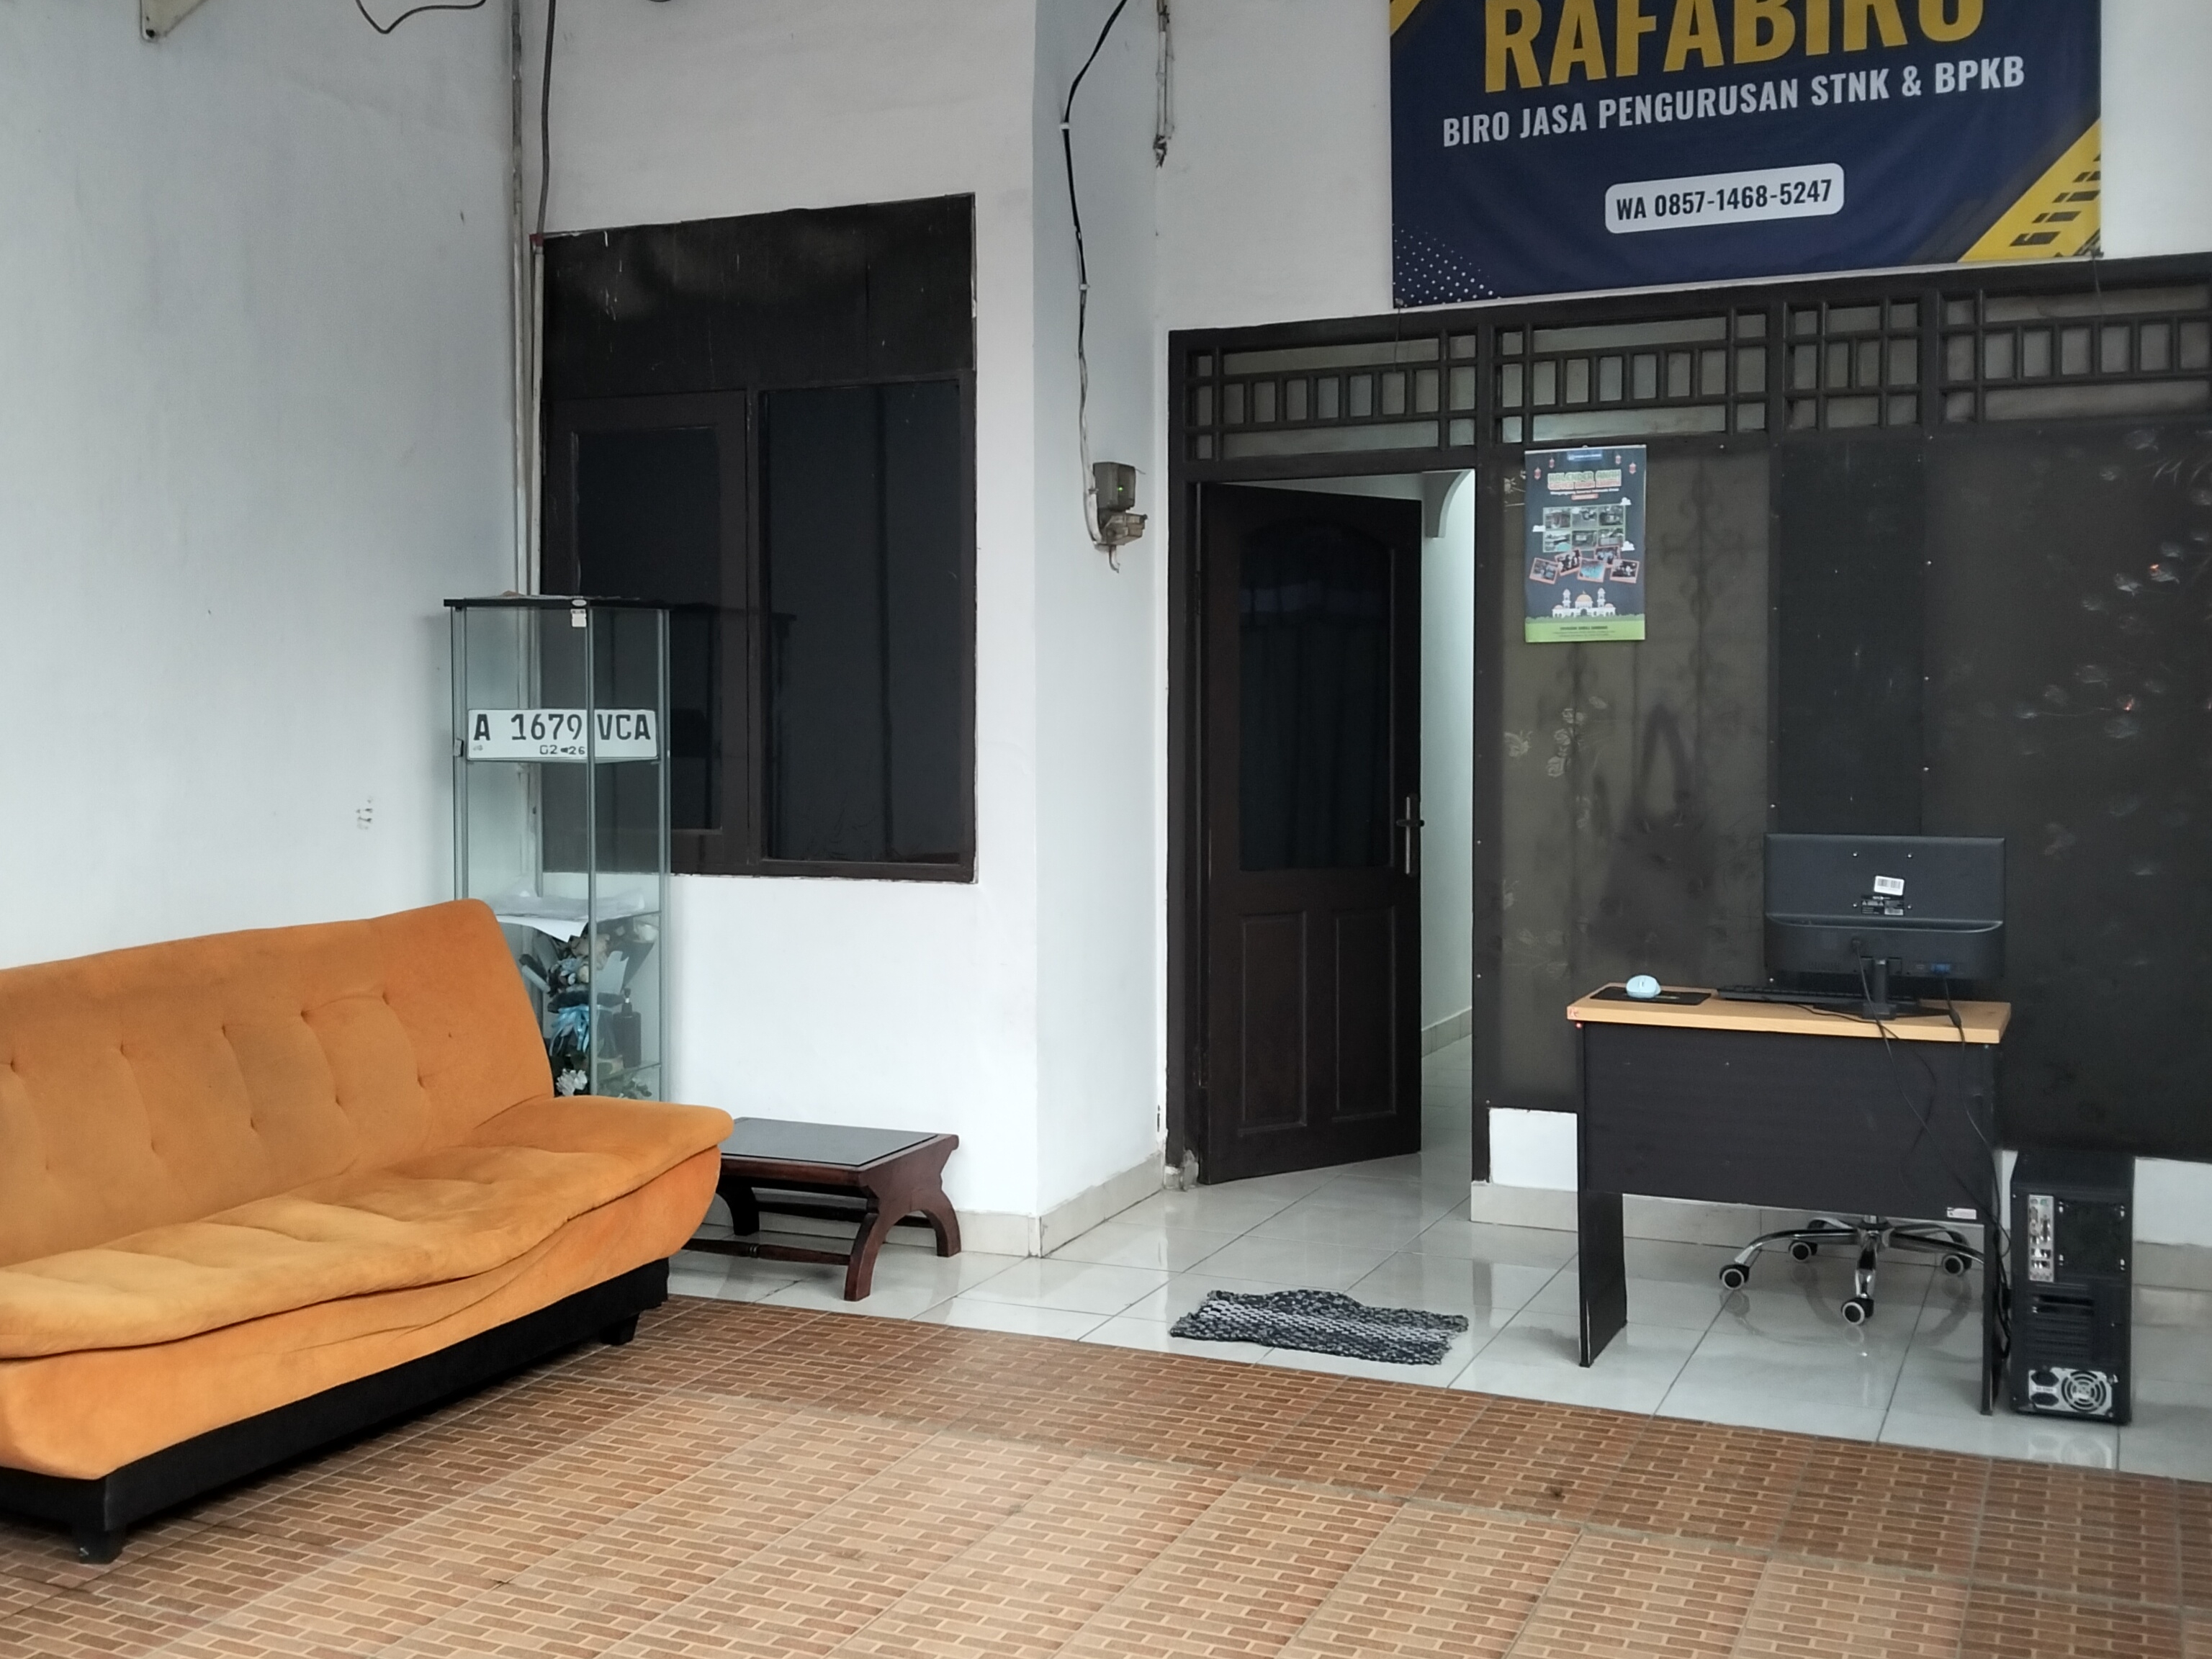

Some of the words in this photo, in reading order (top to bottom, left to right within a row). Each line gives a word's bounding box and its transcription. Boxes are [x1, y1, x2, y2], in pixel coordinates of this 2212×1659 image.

[1443, 111, 1509, 147] BIRO
[1520, 102, 1588, 138] JASA
[1599, 78, 1799, 129] PENGURUSAN
[1811, 68, 1890, 106] STNK
[1902, 66, 1921, 96] &
[1935, 55, 2025, 94] BPKB
[1616, 197, 1647, 220] WA
[1654, 179, 1833, 217] 0857-1468-5247
[473, 714, 491, 741] A
[511, 714, 583, 740] 1679
[597, 714, 651, 740] VCA
